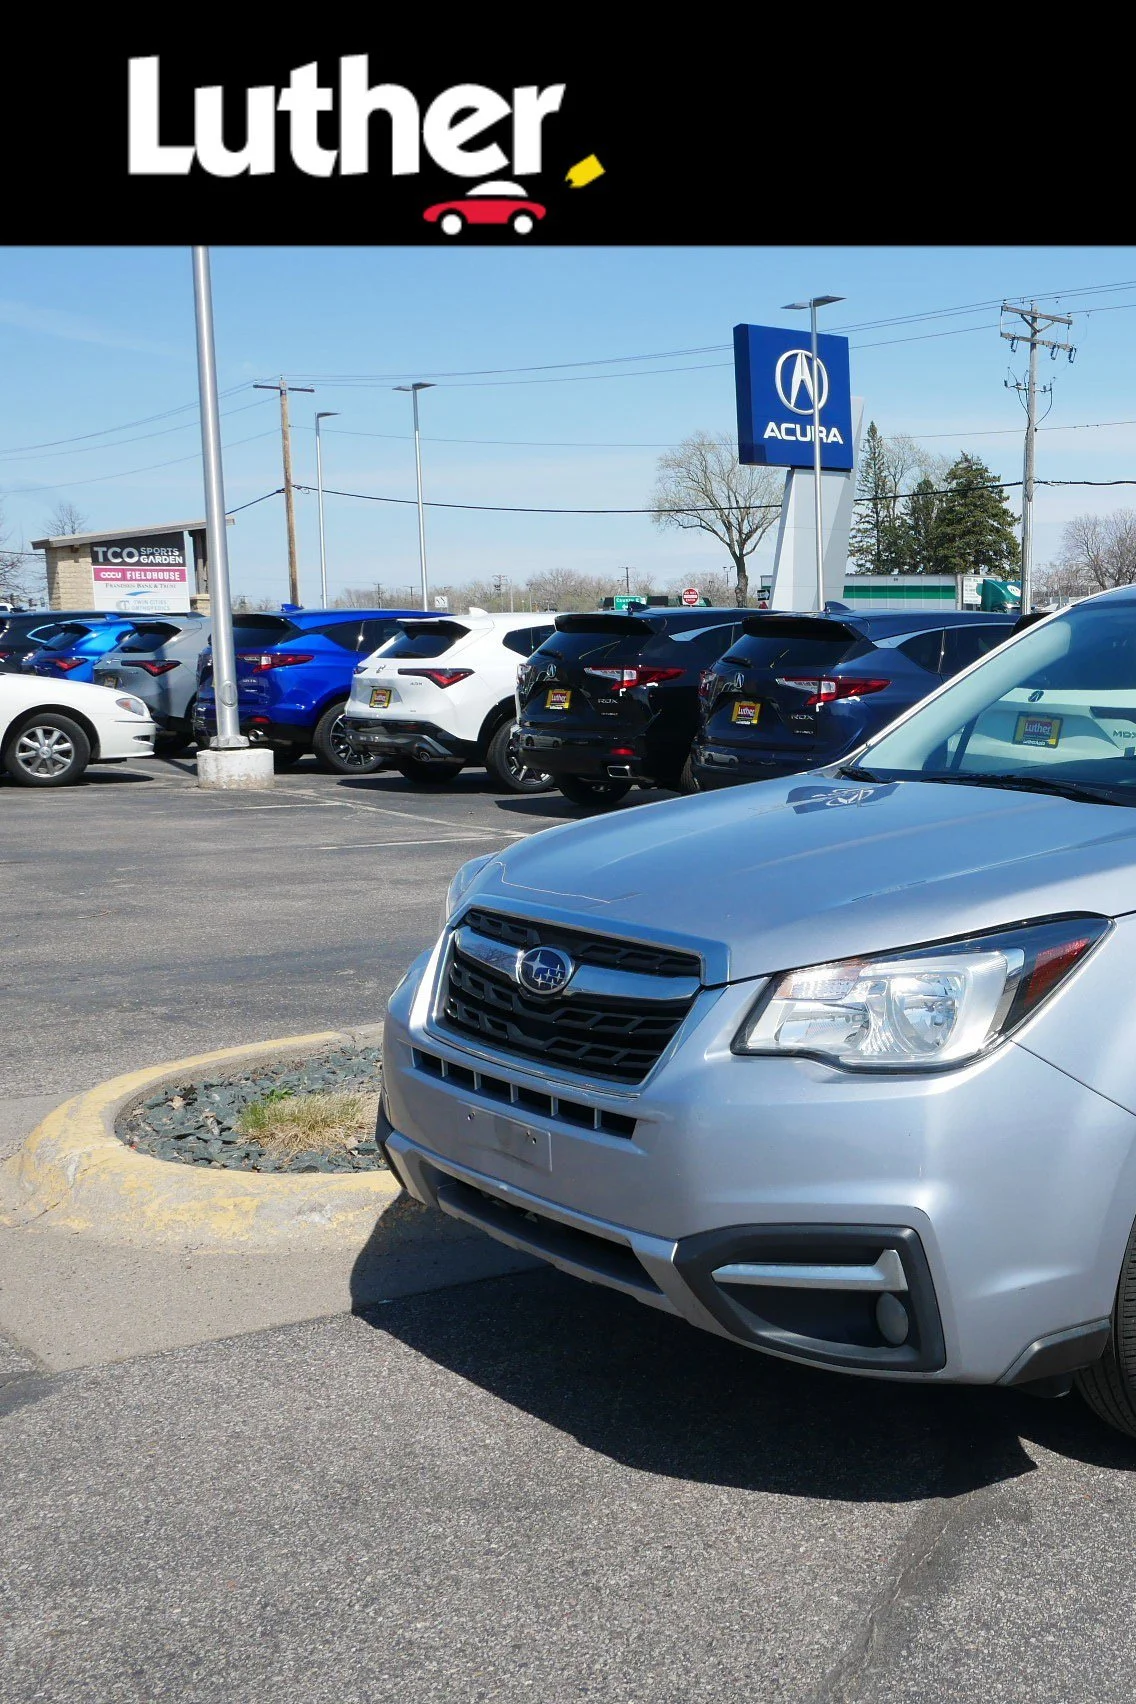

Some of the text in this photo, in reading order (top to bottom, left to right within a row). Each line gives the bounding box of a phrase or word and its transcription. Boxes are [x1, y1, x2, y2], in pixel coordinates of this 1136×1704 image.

[763, 421, 843, 444] ACURA
[93, 546, 139, 564] TCO
[140, 547, 180, 556] SPORTS
[140, 556, 184, 564] GARDEN
[126, 571, 181, 580] FIELDHOUSE
[1025, 722, 1052, 734] Luther
